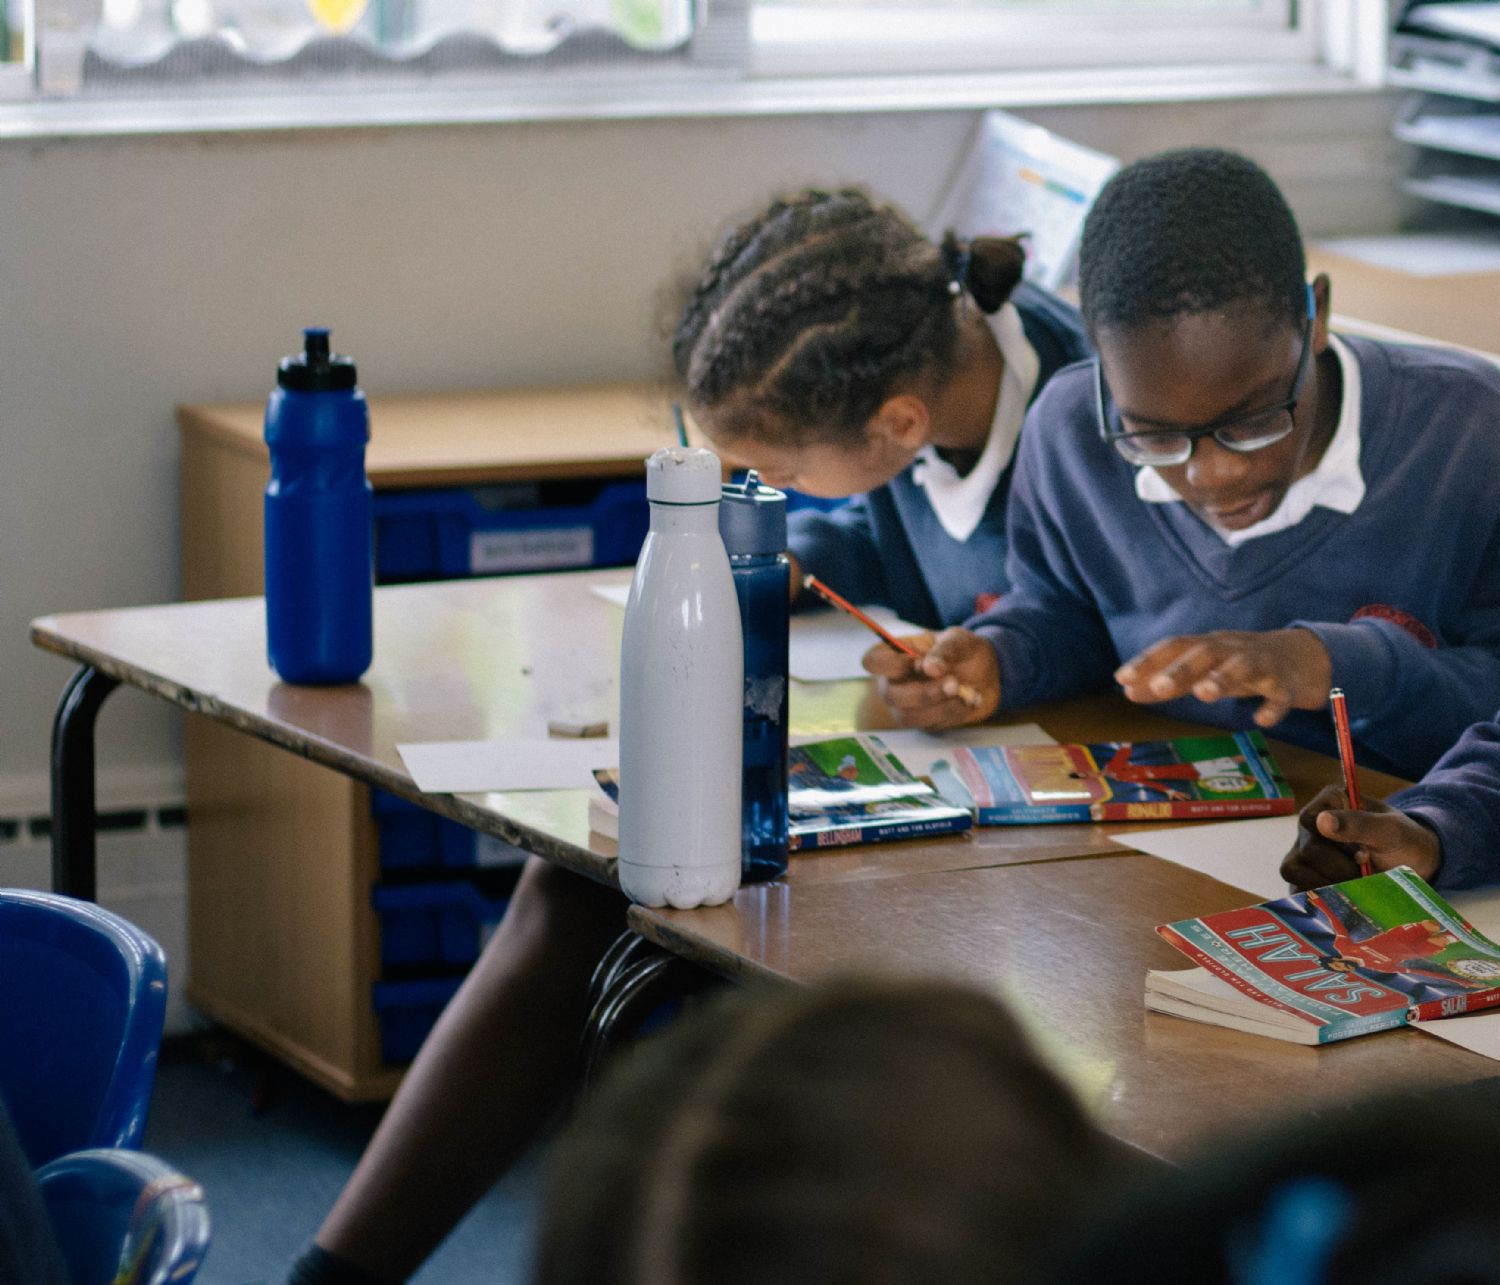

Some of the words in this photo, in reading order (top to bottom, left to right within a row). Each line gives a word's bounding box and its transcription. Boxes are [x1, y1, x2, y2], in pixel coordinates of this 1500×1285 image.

[1126, 803, 1173, 818] RONALDO
[817, 827, 863, 847] BELLINGHAM
[878, 827, 895, 835] MATT
[897, 825, 910, 833] AND
[911, 823, 923, 831] TOM
[1225, 922, 1386, 1004] SALAH
[1441, 994, 1468, 1016] SALAH
[1486, 993, 1500, 1001] MATT
